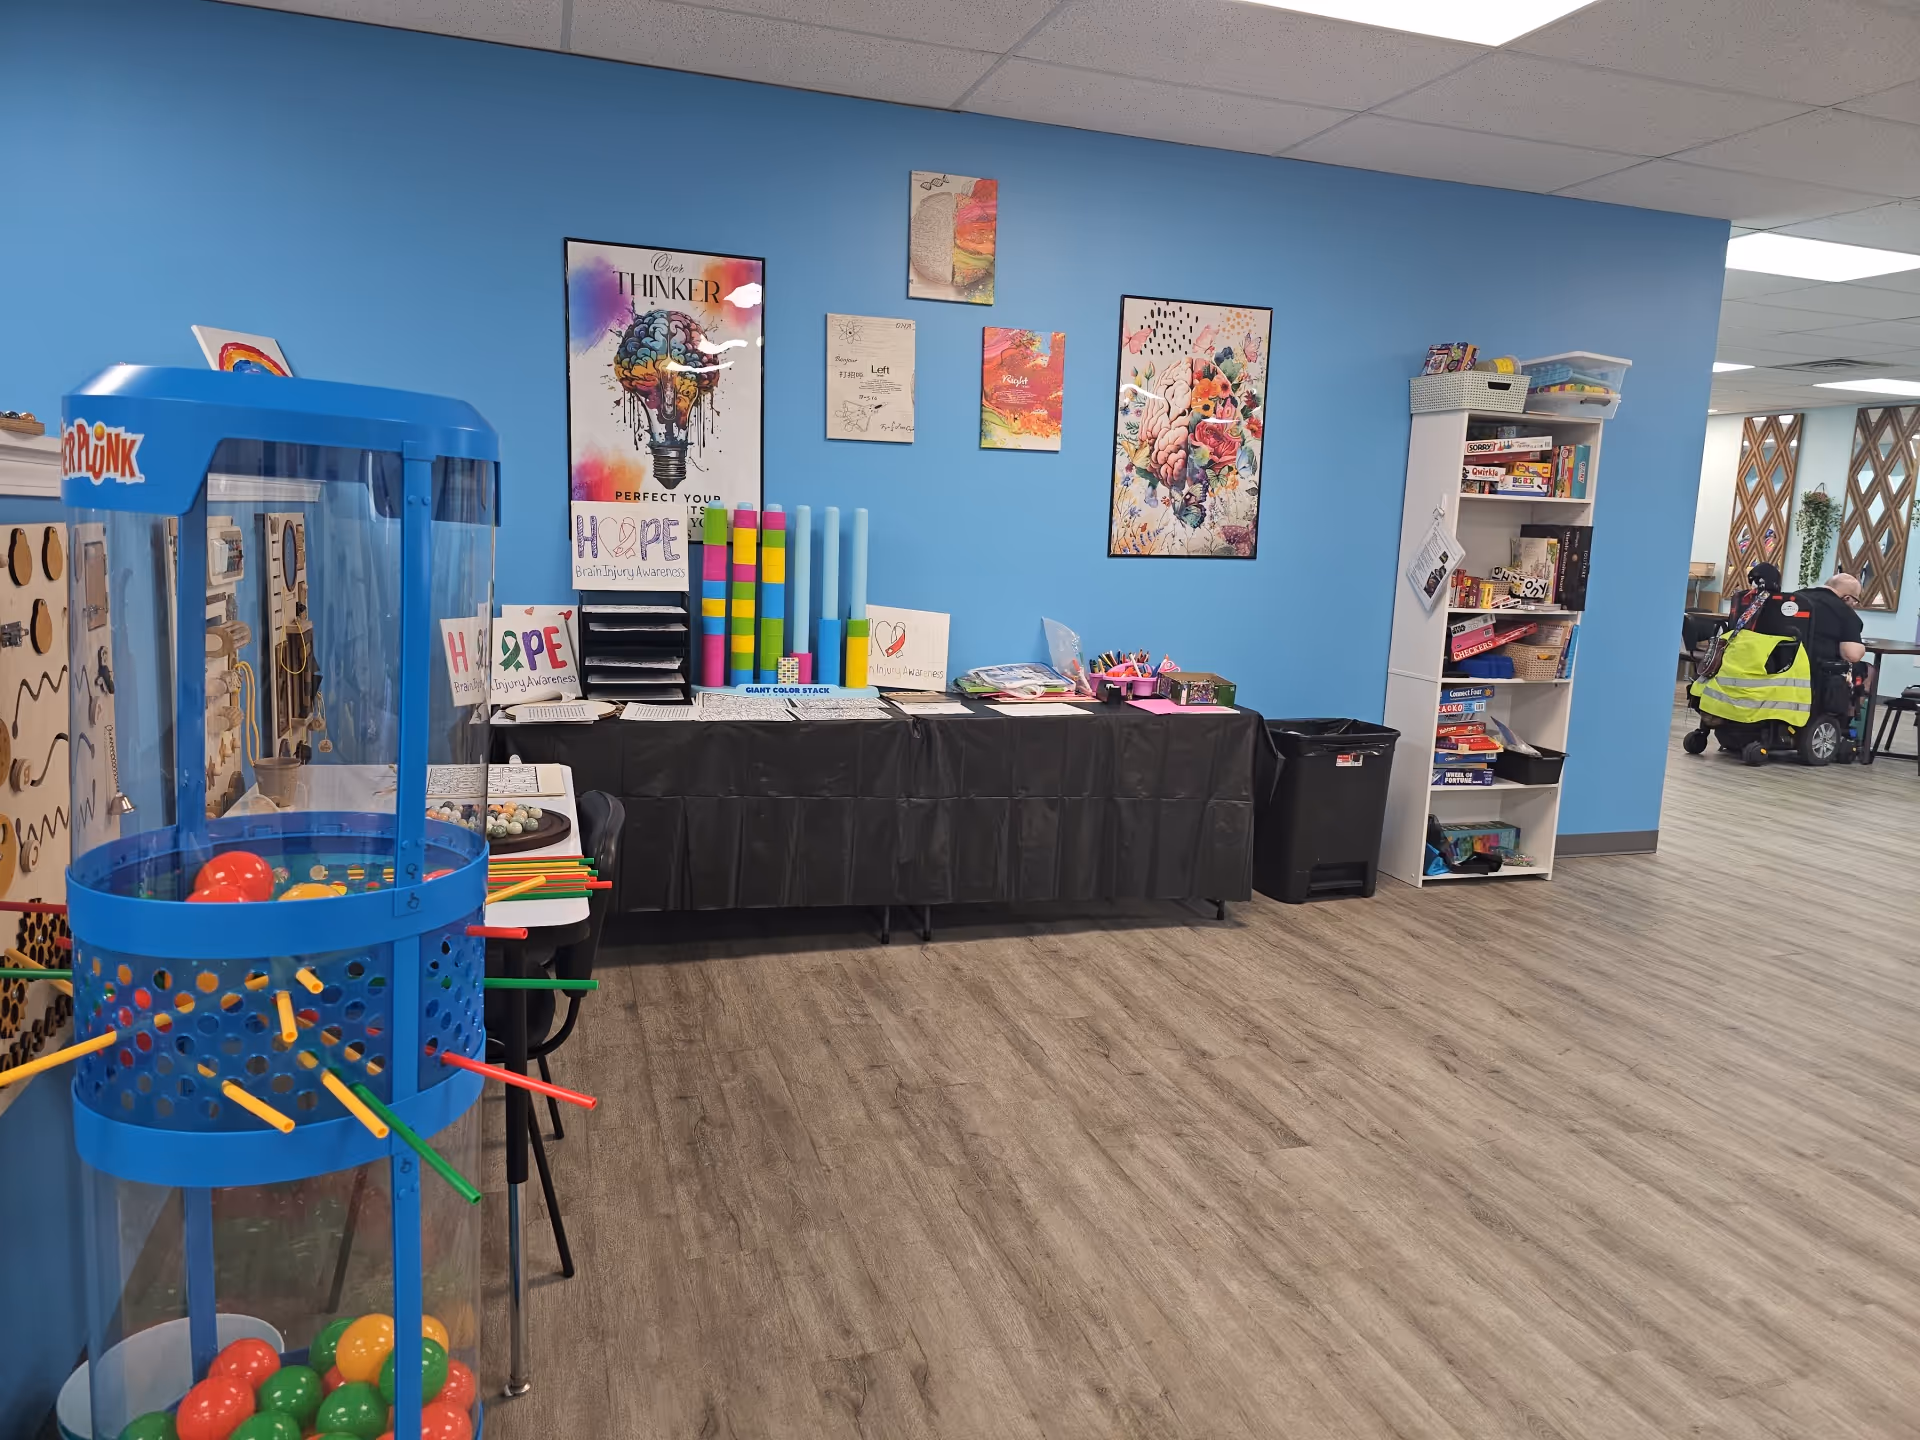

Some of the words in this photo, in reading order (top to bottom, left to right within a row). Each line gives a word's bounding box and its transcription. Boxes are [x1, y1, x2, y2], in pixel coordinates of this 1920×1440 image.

[651, 252, 684, 273] Over
[612, 270, 720, 304] THINKER
[871, 364, 890, 375] Left
[1002, 374, 1029, 387] Right
[615, 491, 677, 502] PERFECT
[576, 565, 601, 577] Brain
[601, 565, 634, 580] Injury
[636, 565, 686, 578] Awareness
[1453, 640, 1493, 661] CHECKERS
[527, 674, 577, 689] Awareness
[1449, 689, 1471, 698] Connect
[1470, 688, 1483, 696] Four
